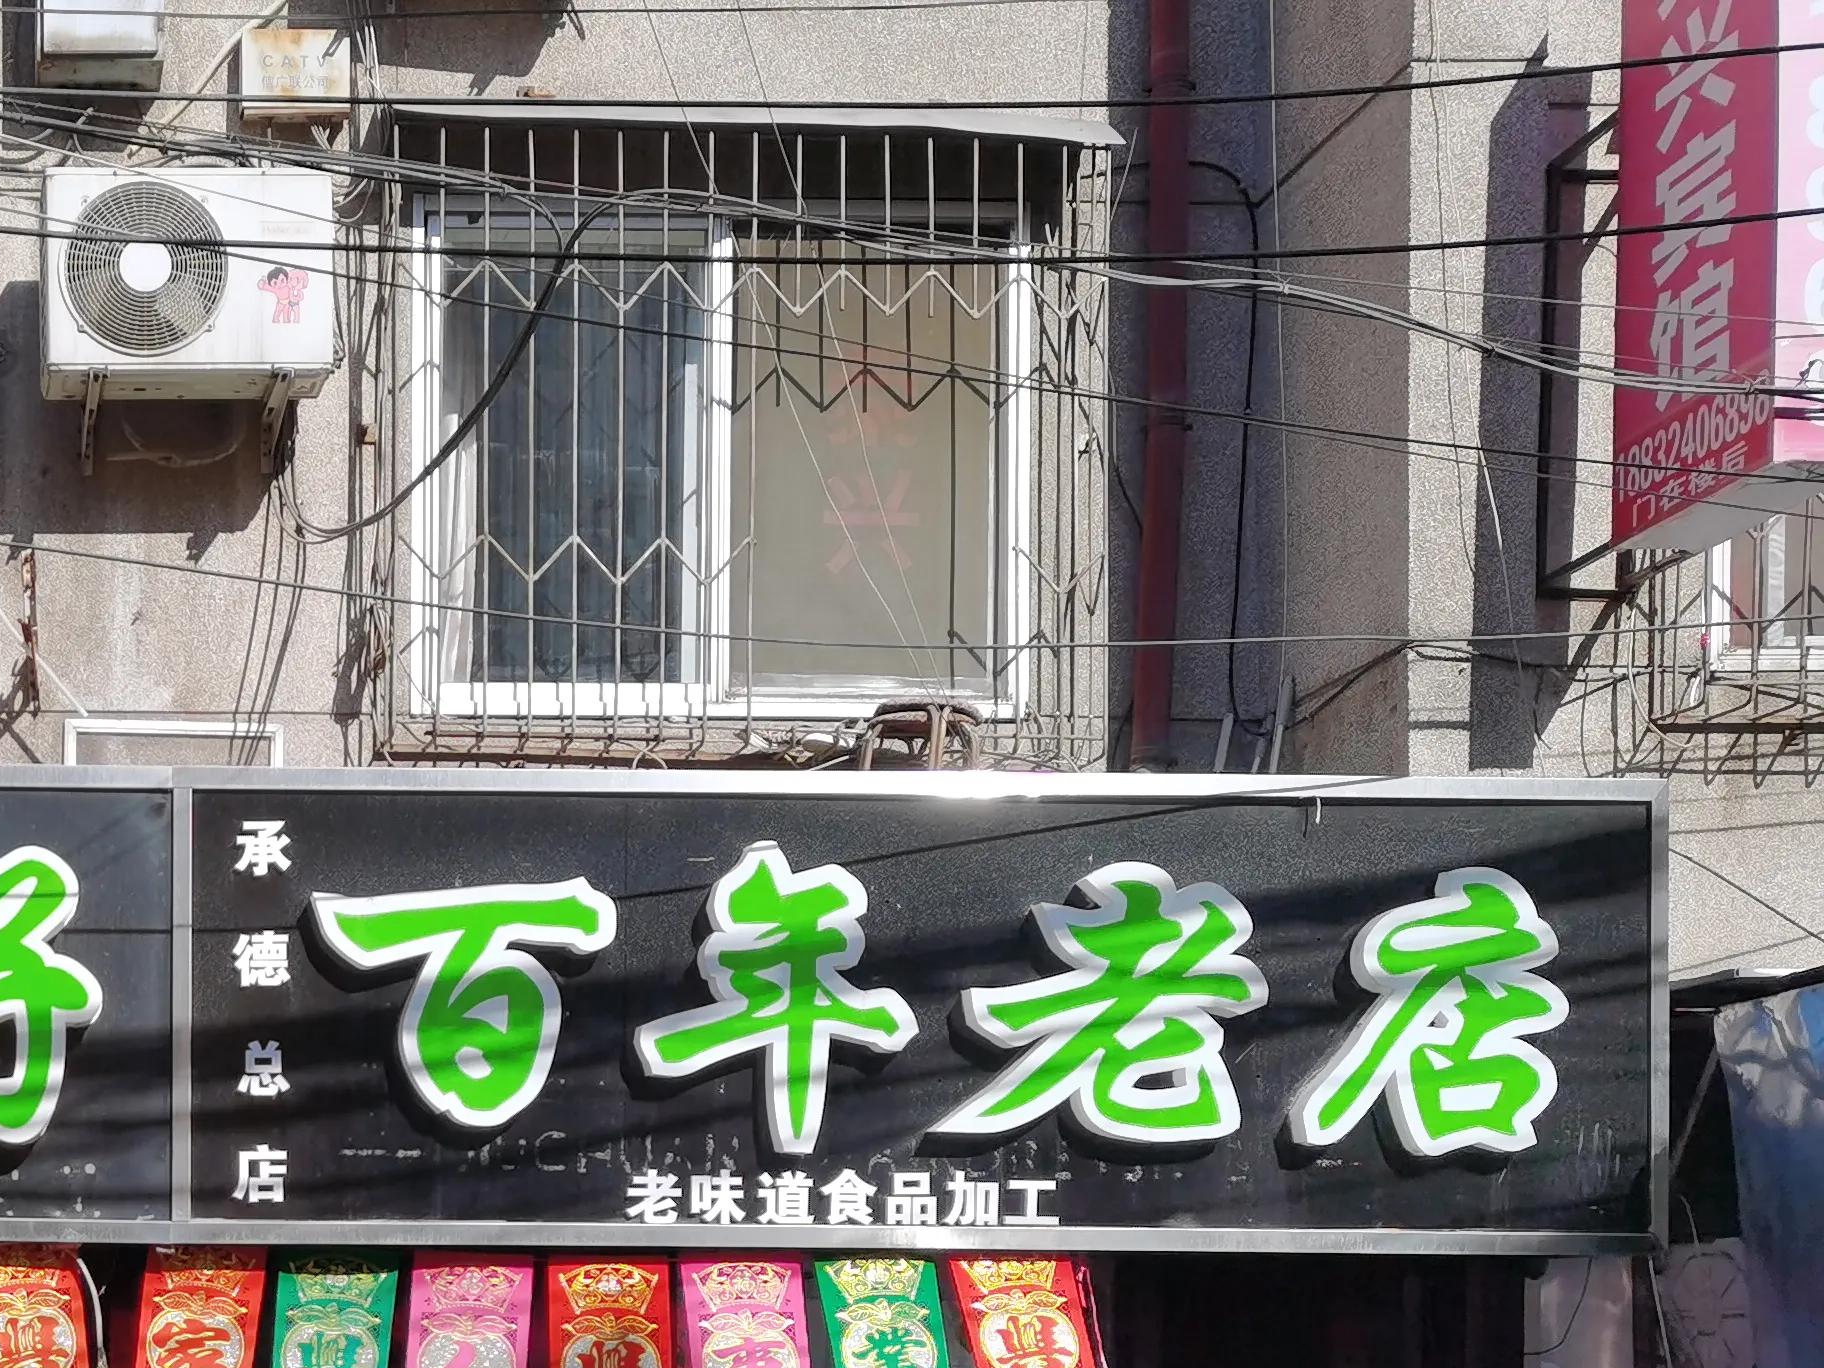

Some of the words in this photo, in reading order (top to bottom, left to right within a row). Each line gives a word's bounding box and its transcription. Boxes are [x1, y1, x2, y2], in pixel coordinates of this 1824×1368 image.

[1650, 0, 1739, 411] 兴宾馆
[232, 820, 293, 1203] 承德总店
[311, 841, 1571, 1156] 百年老店
[626, 1169, 1061, 1226] 老味道食品加工
